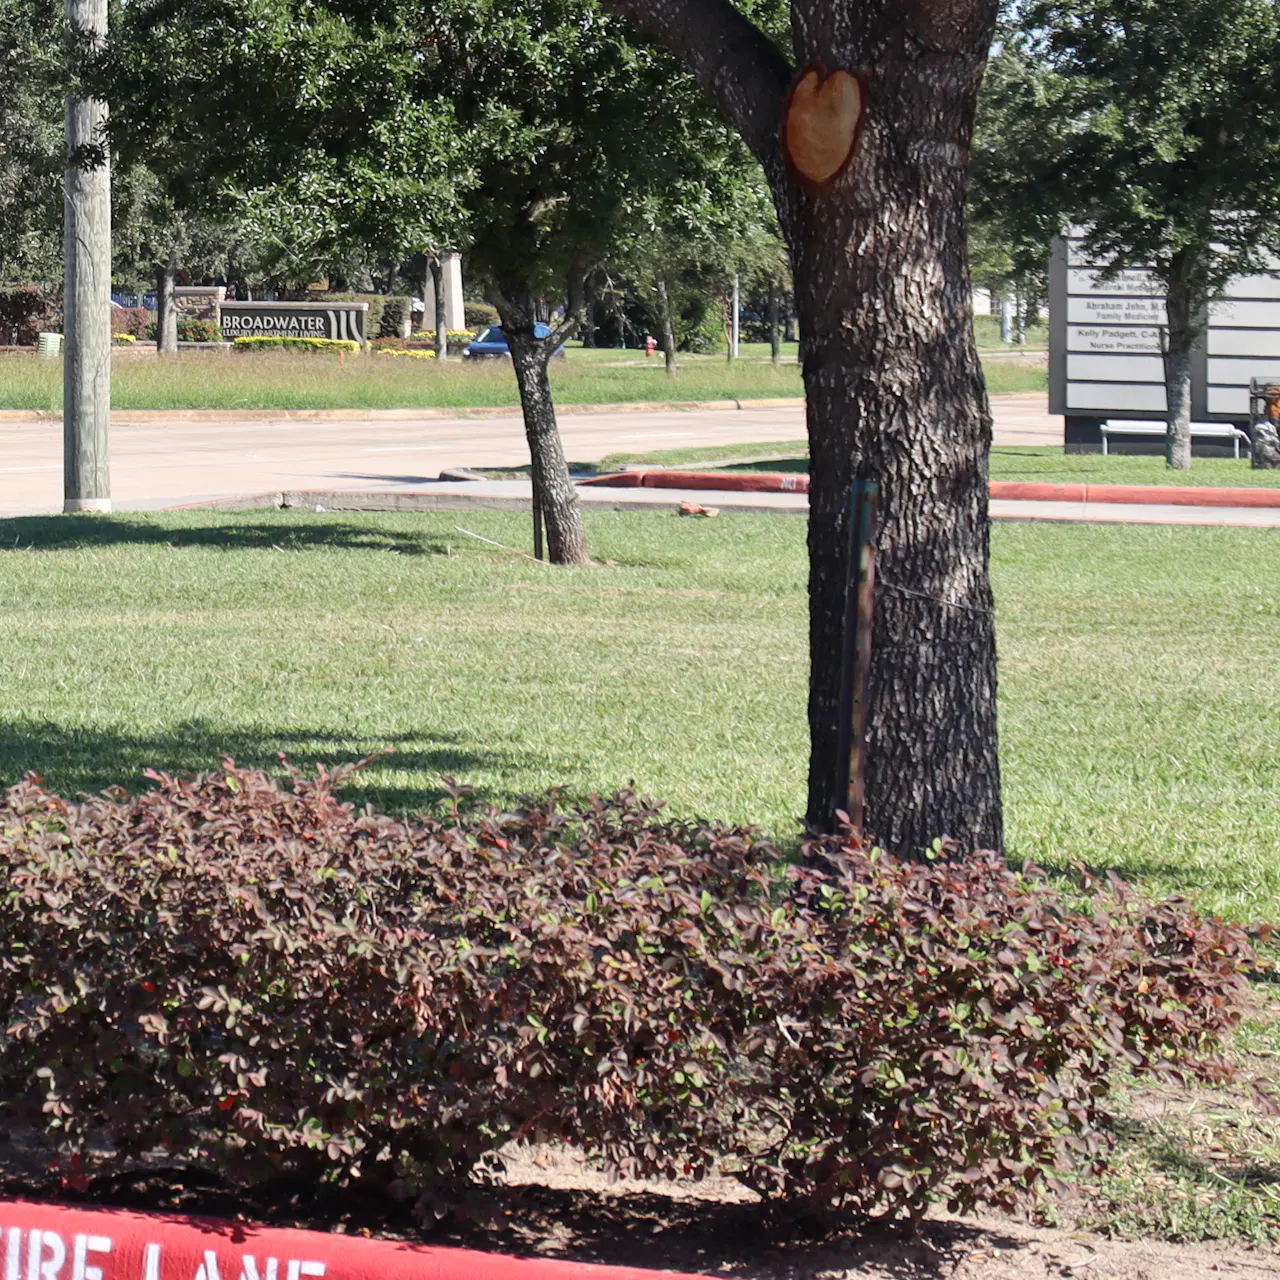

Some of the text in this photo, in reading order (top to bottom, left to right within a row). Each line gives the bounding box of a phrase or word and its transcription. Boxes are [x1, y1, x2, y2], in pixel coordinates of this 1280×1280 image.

[1086, 302, 1123, 310] Abraham
[1125, 302, 1148, 311] John,
[1096, 312, 1159, 321] Family Medicine
[222, 315, 325, 330] BROADWATER
[222, 329, 326, 338] LUXURY APARTMENT LIVING
[1077, 329, 1100, 338] Kelly
[1141, 330, 1159, 339] C-A
[1090, 342, 1115, 350] Nurse
